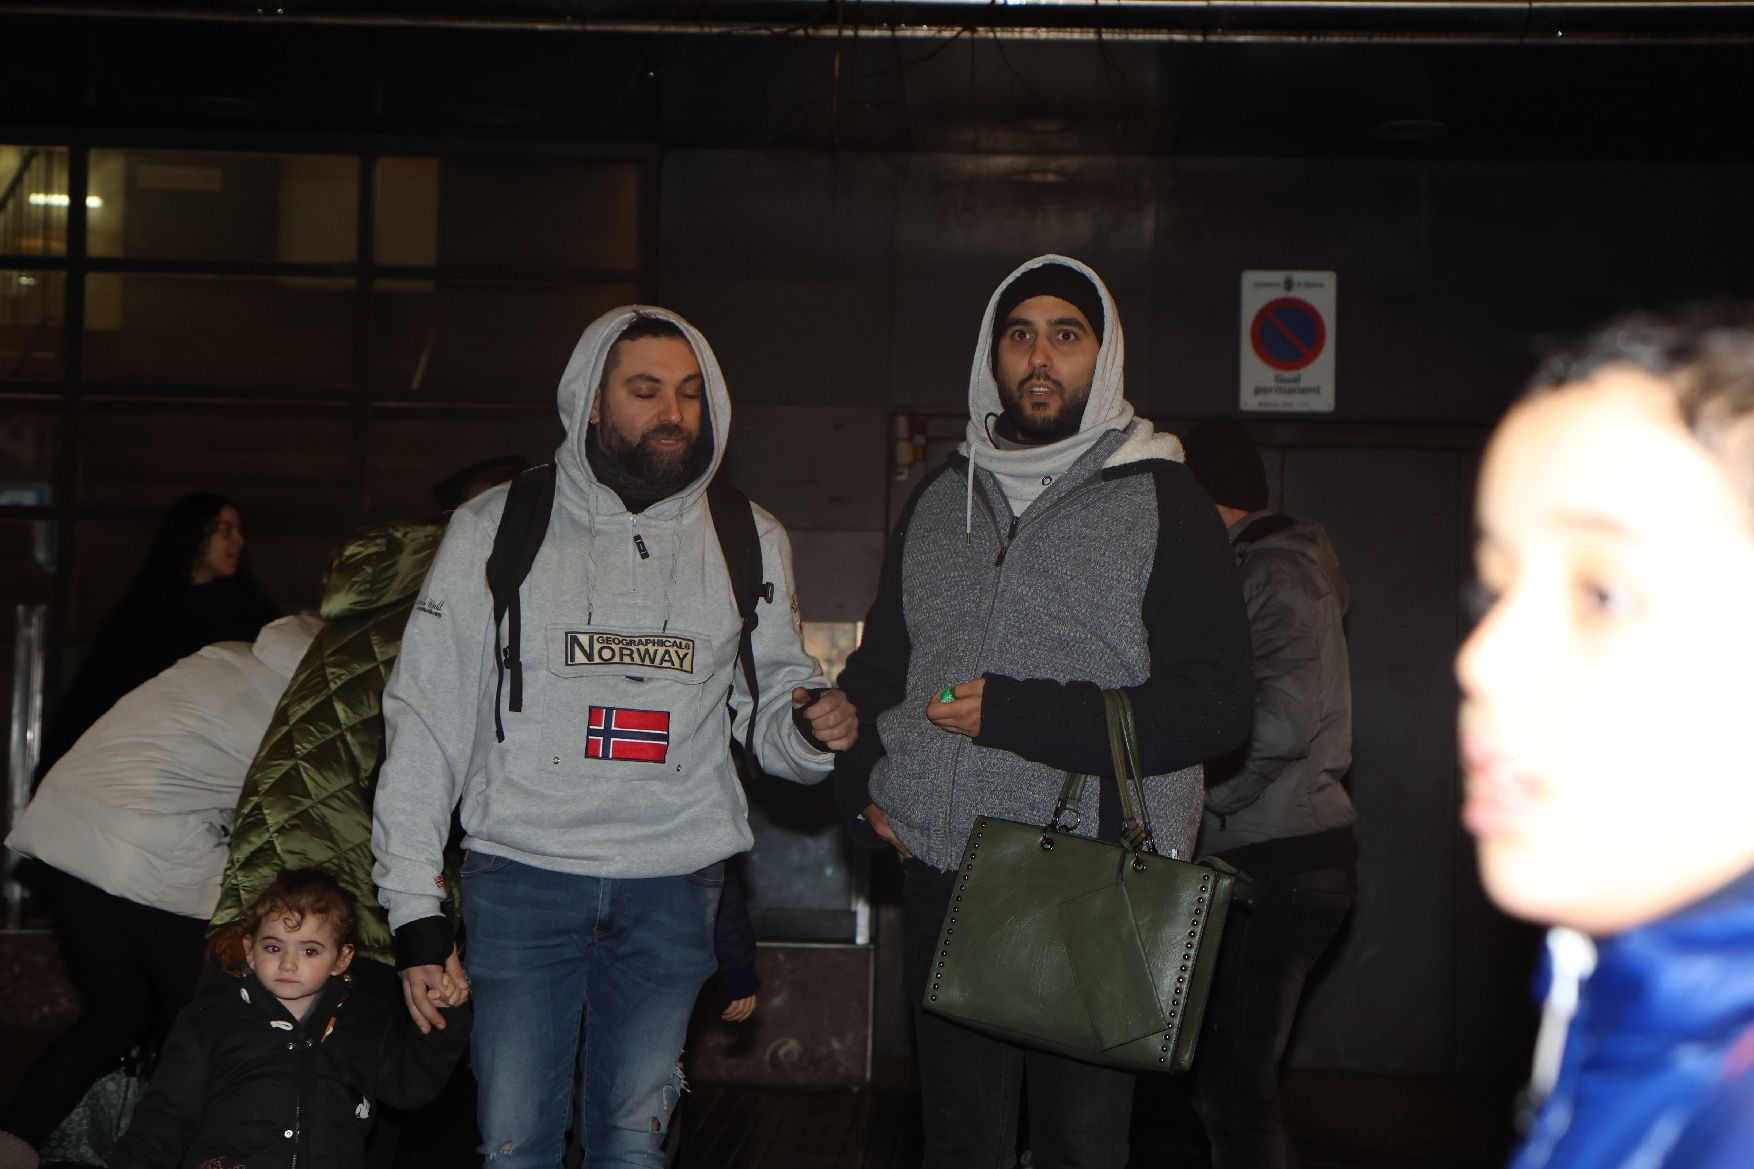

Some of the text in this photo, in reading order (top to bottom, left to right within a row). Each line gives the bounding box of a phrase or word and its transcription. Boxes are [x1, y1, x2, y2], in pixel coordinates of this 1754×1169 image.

[1274, 374, 1301, 384] Gual
[1254, 385, 1320, 397] permanent
[570, 634, 690, 669] NORWAY
